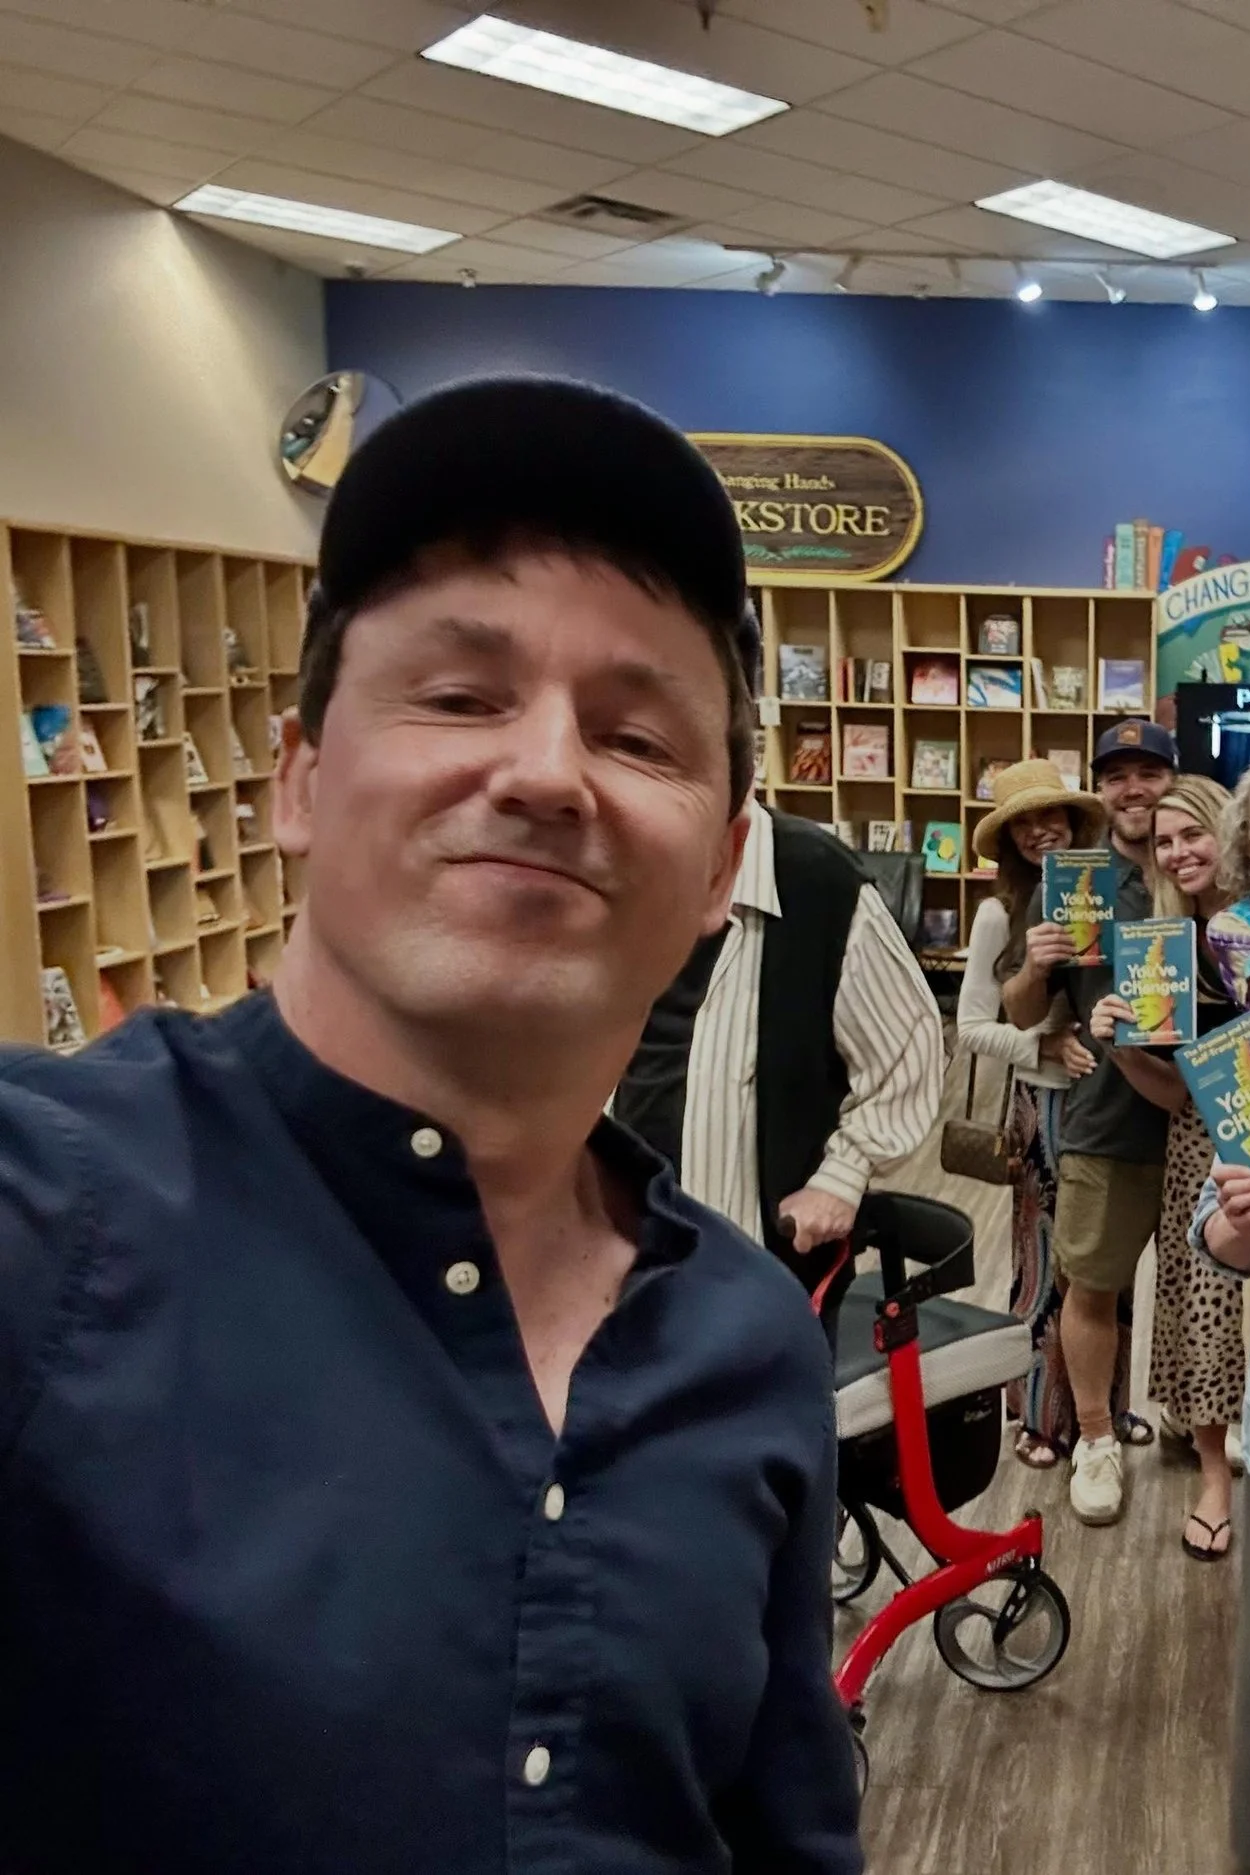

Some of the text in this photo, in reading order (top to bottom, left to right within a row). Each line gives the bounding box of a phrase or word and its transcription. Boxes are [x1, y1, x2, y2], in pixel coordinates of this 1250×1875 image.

[725, 472, 836, 490] anging Hands
[733, 500, 890, 536] KSTORE
[1052, 906, 1114, 923] Changed
[1119, 976, 1190, 998] Changed
